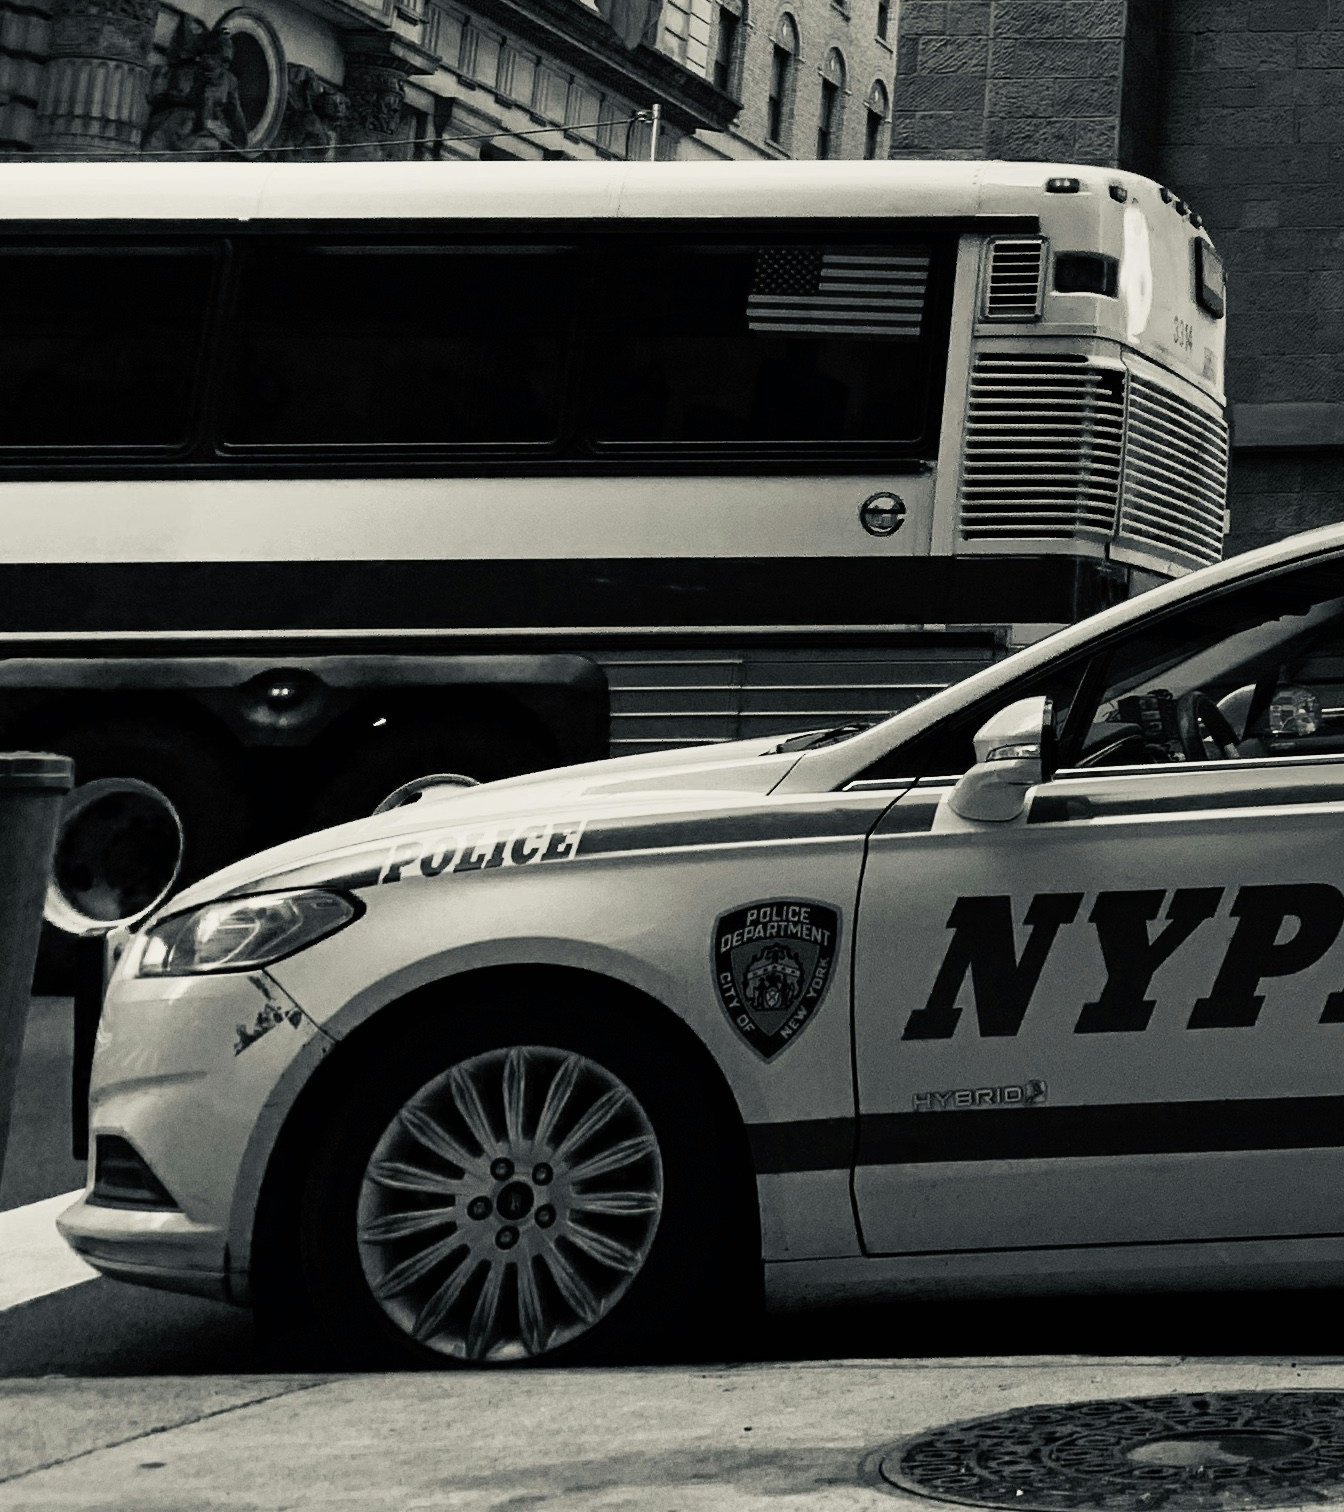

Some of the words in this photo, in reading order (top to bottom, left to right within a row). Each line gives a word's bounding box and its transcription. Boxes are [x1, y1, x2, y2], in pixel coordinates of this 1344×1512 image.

[382, 820, 583, 884] POLICE
[720, 922, 832, 954] DEPARTMENT
[746, 906, 811, 926] POLICE
[719, 972, 740, 1008] CITY
[736, 1014, 756, 1032] OF
[780, 1006, 808, 1040] NEW
[806, 957, 829, 998] YORK
[912, 1085, 1024, 1111] HYBRID
